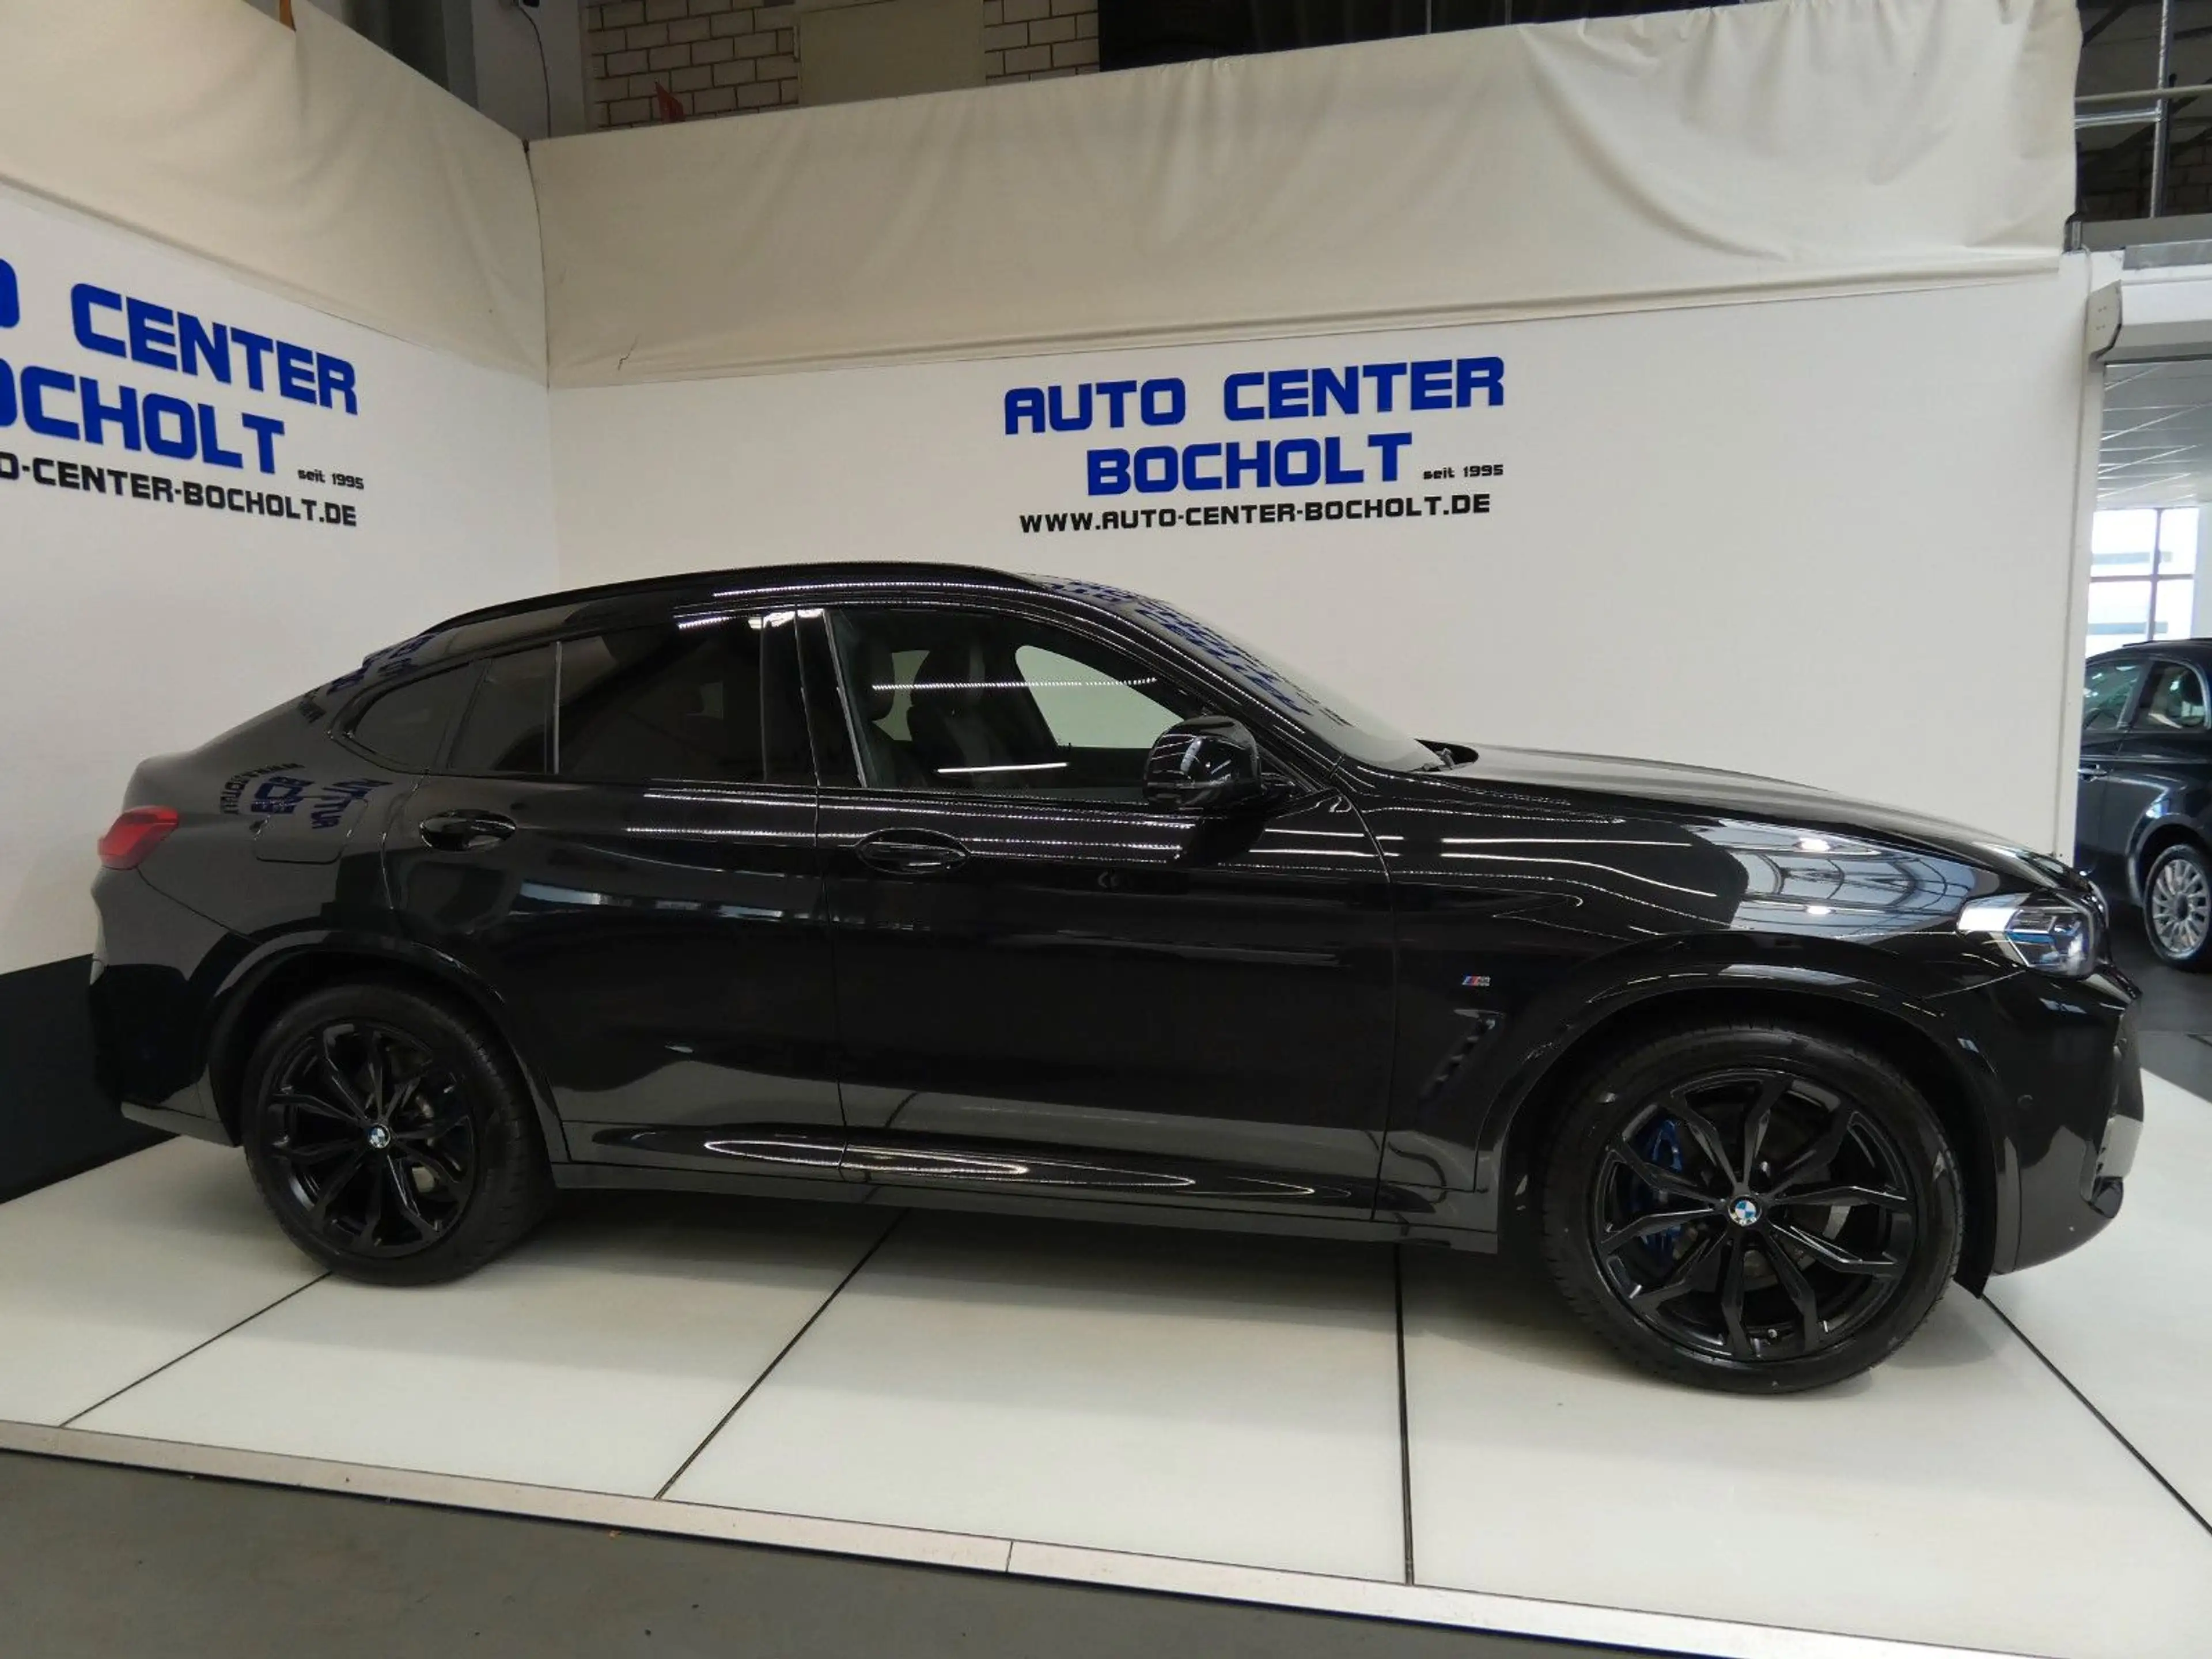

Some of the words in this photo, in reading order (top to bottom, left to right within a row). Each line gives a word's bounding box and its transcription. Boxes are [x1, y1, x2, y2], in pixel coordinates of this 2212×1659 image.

[70, 283, 358, 415] CENTER
[1004, 377, 1186, 435] AUTO
[1224, 357, 1505, 422] CENTER
[331, 473, 364, 490] 1995
[1086, 432, 1412, 496] BOCHOLT
[1423, 467, 1455, 480] seit
[1463, 464, 1503, 478] 1995
[1019, 493, 1490, 533] WWW.AUTO-CENTER-BOCHOLT.DE
